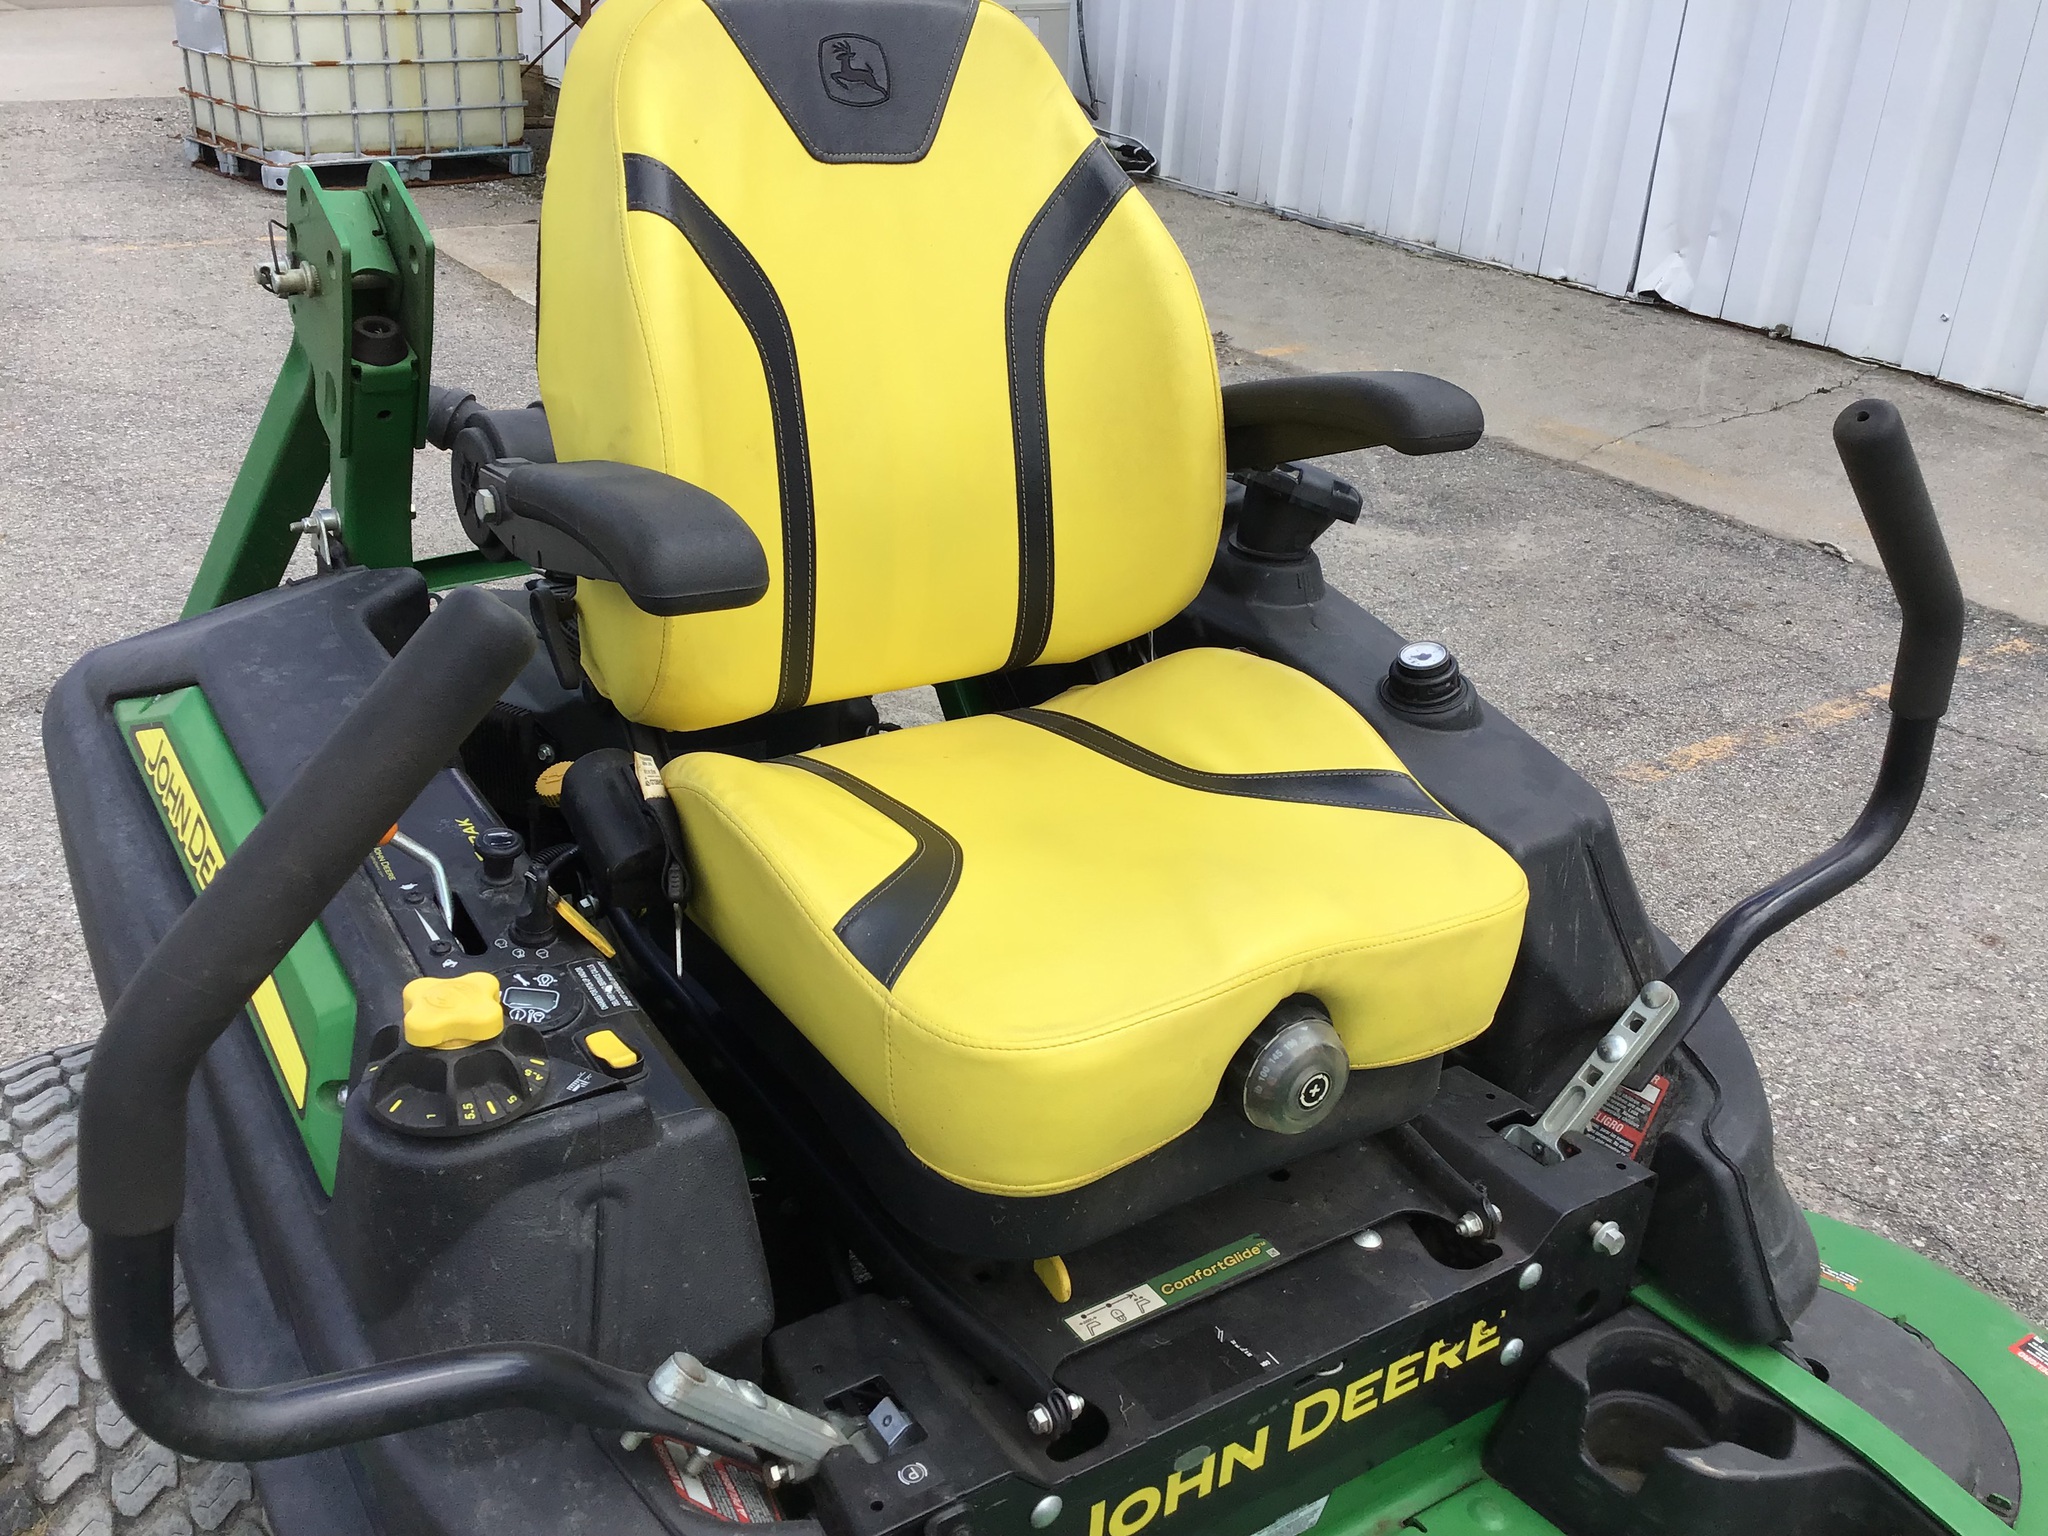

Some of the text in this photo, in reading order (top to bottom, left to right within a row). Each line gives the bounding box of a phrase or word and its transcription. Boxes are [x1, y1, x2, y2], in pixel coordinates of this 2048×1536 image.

[147, 738, 192, 838] JOHN
[381, 861, 397, 881] DEERE
[1269, 1049, 1283, 1063] 145
[1259, 1066, 1270, 1081] 100
[506, 1095, 518, 1105] 5
[462, 1102, 476, 1120] 5.5
[1089, 1310, 1507, 1536] JOHN DEERE
